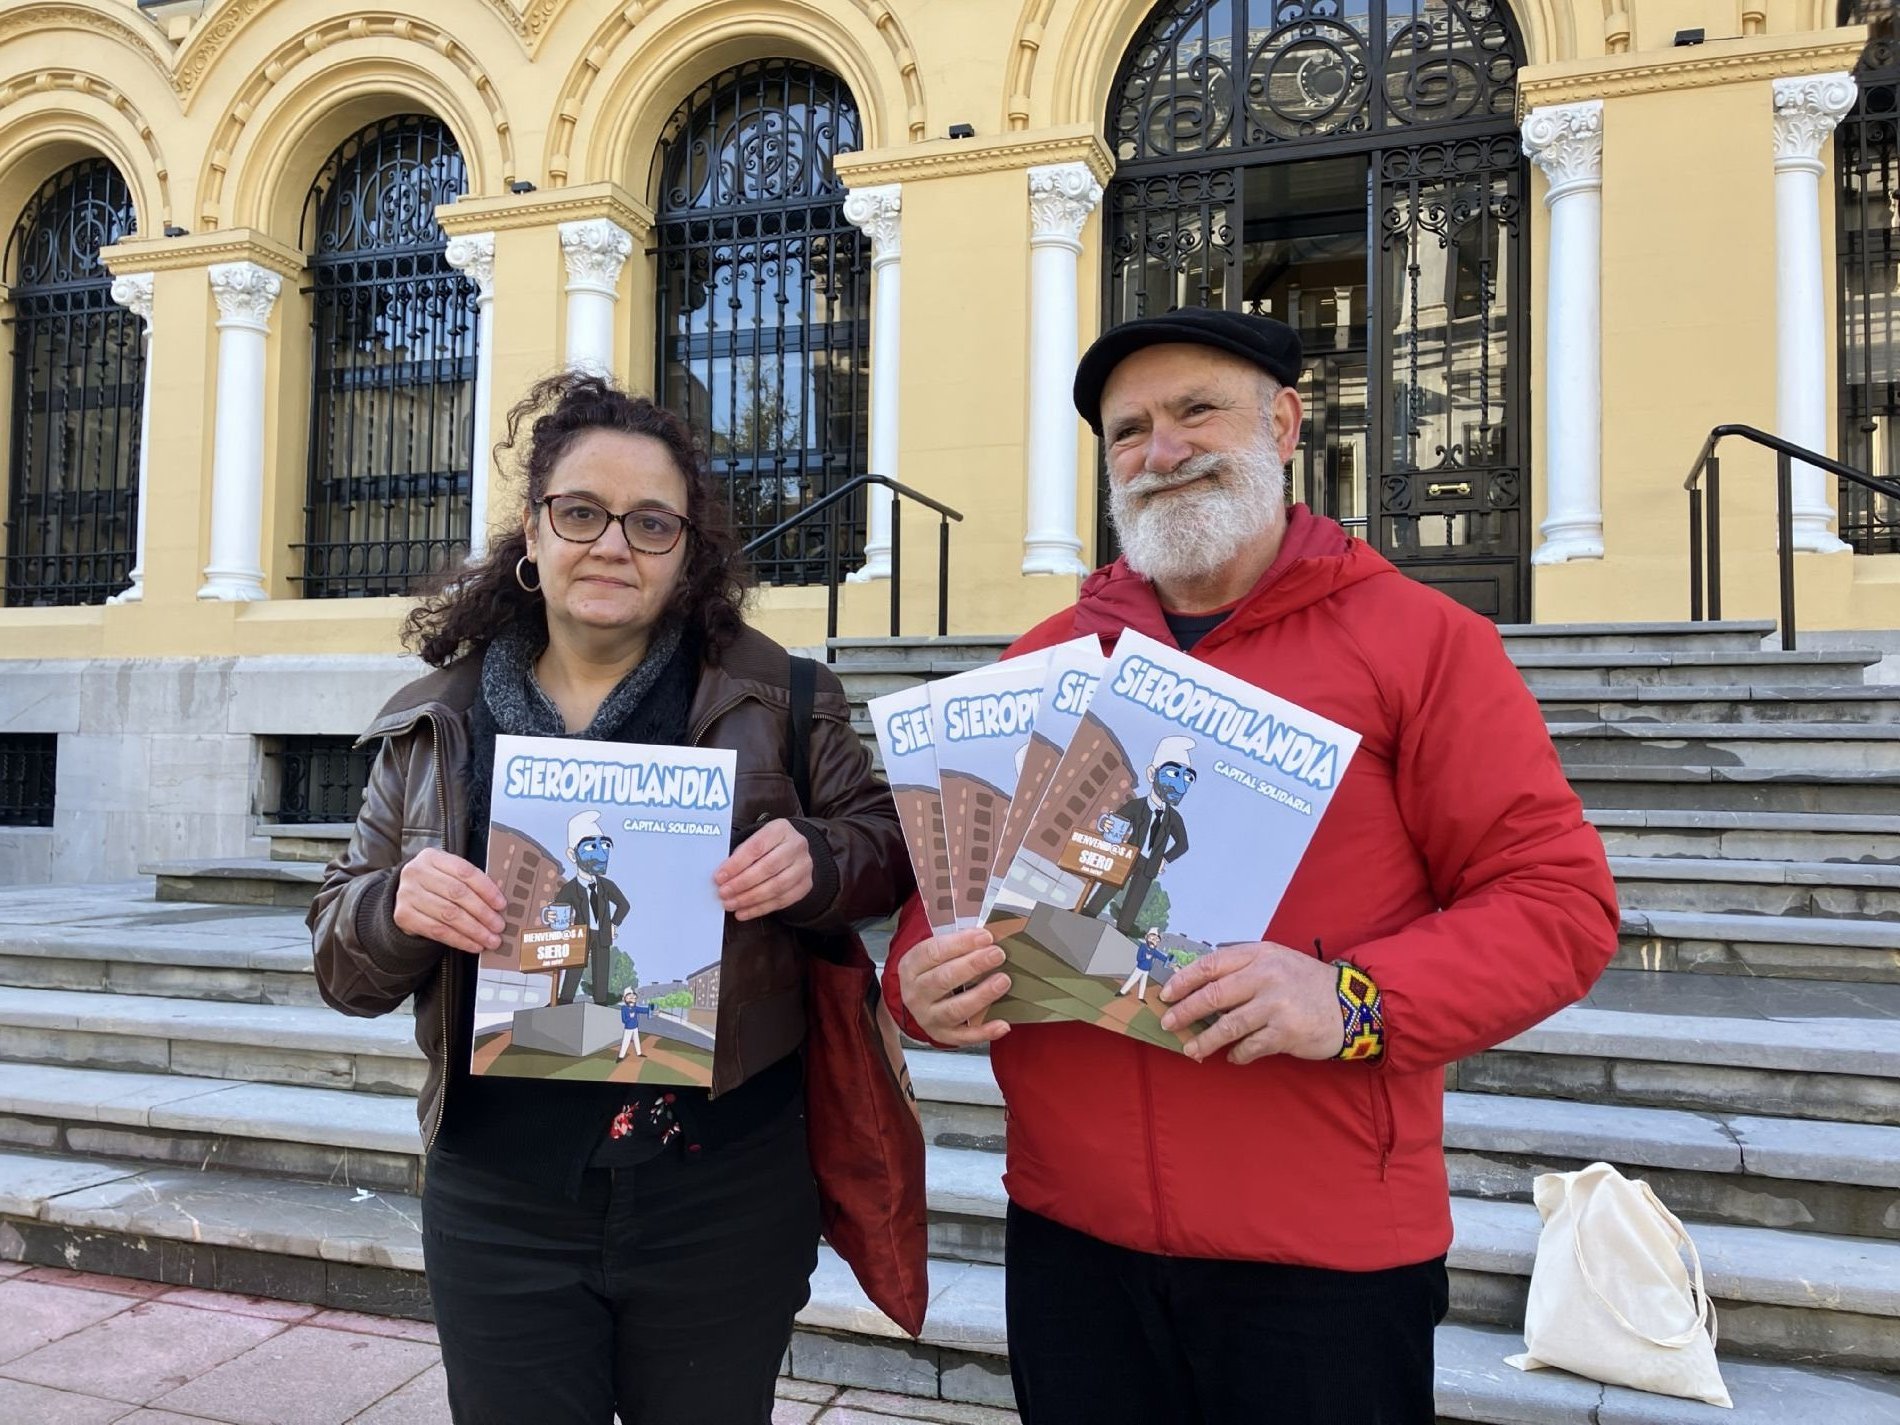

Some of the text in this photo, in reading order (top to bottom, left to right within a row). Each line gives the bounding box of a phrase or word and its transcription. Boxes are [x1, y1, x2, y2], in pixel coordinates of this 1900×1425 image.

[1213, 760, 1312, 816] CAPITAL SOLIDARIA
[623, 818, 722, 836] CAPITAL SOLIDARIA
[1078, 849, 1114, 872] SIERO
[1124, 849, 1133, 860] A
[577, 928, 584, 938] A
[536, 943, 570, 960] SIERO
